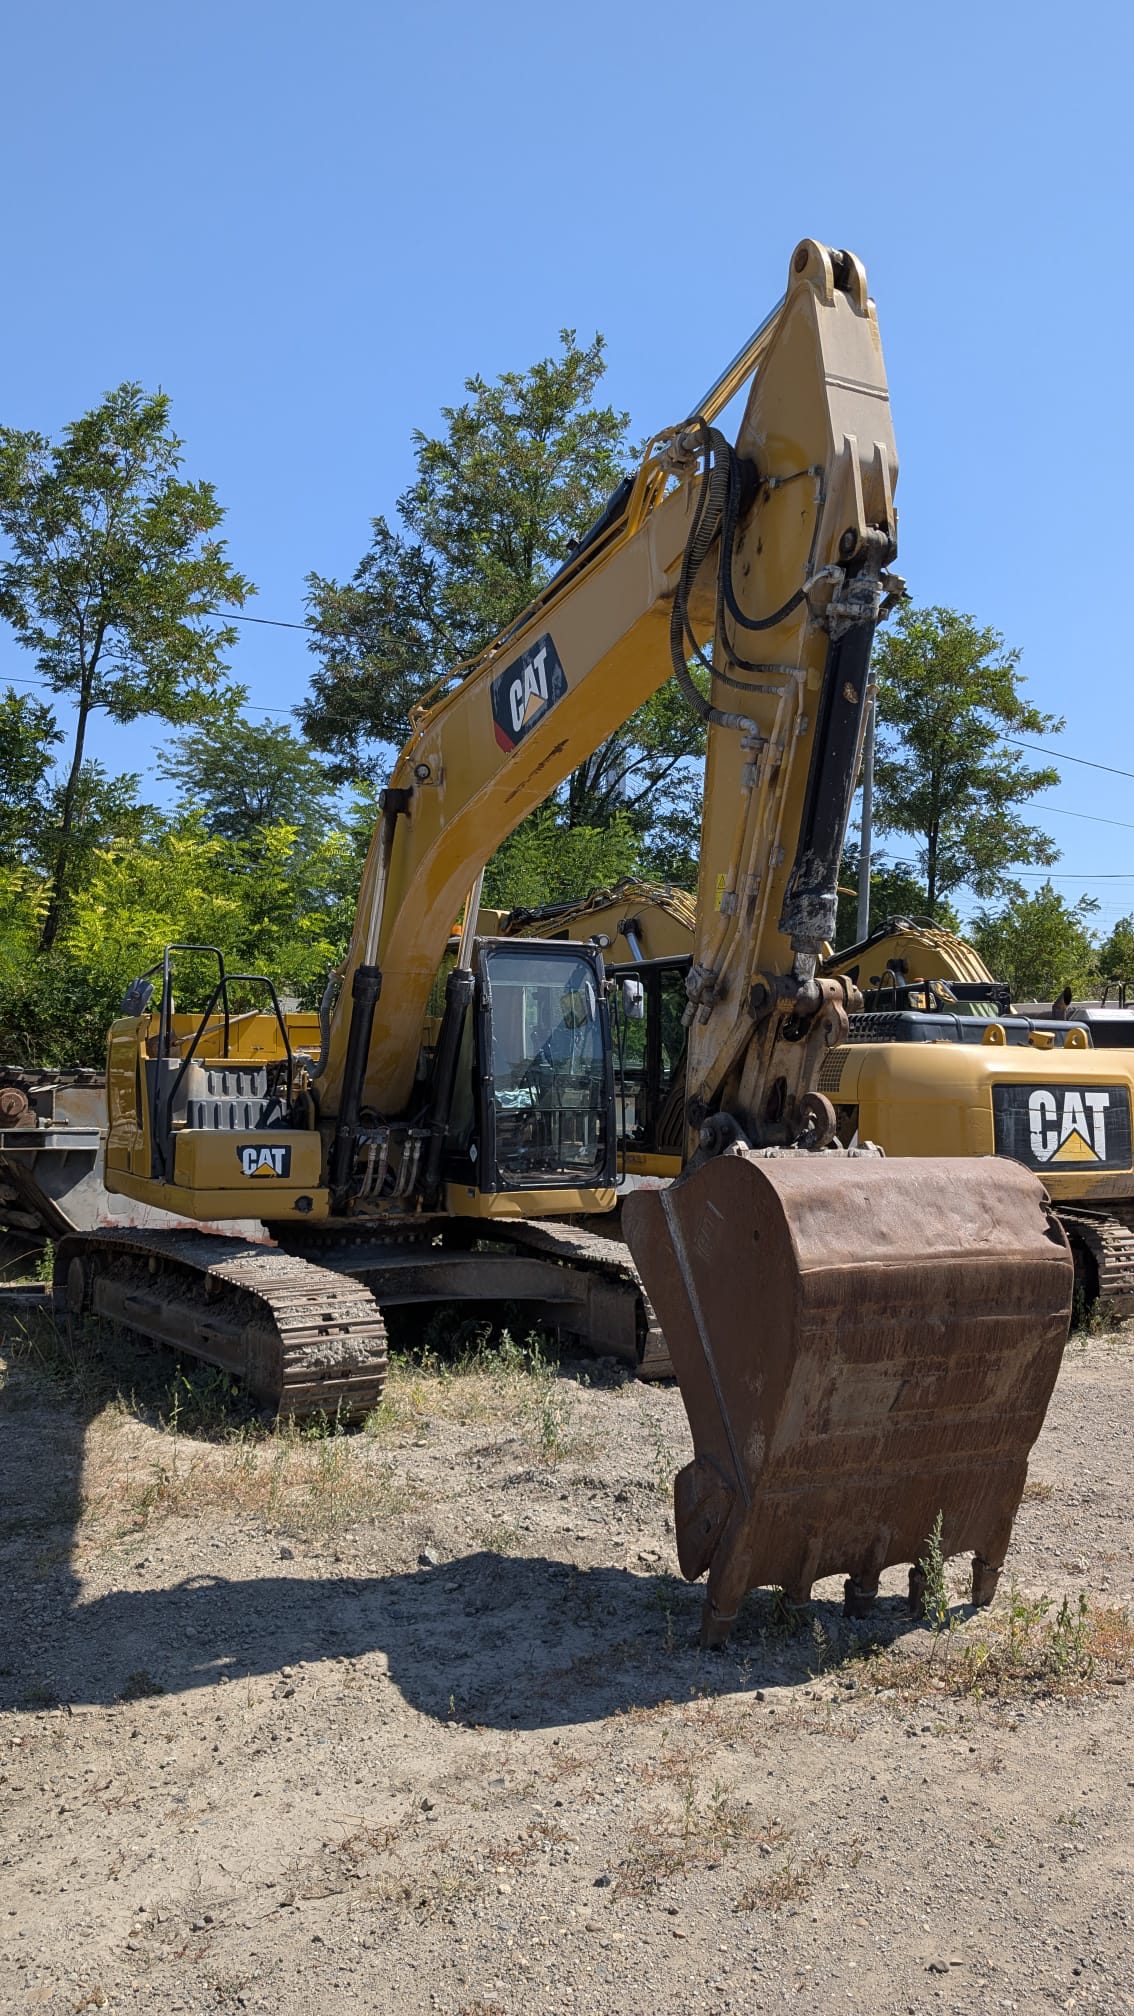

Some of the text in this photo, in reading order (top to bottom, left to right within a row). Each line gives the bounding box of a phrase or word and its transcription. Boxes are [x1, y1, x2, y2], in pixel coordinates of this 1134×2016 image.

[510, 647, 548, 732] CAT
[242, 1148, 286, 1176] CAT
[1029, 1090, 1110, 1162] CAT
